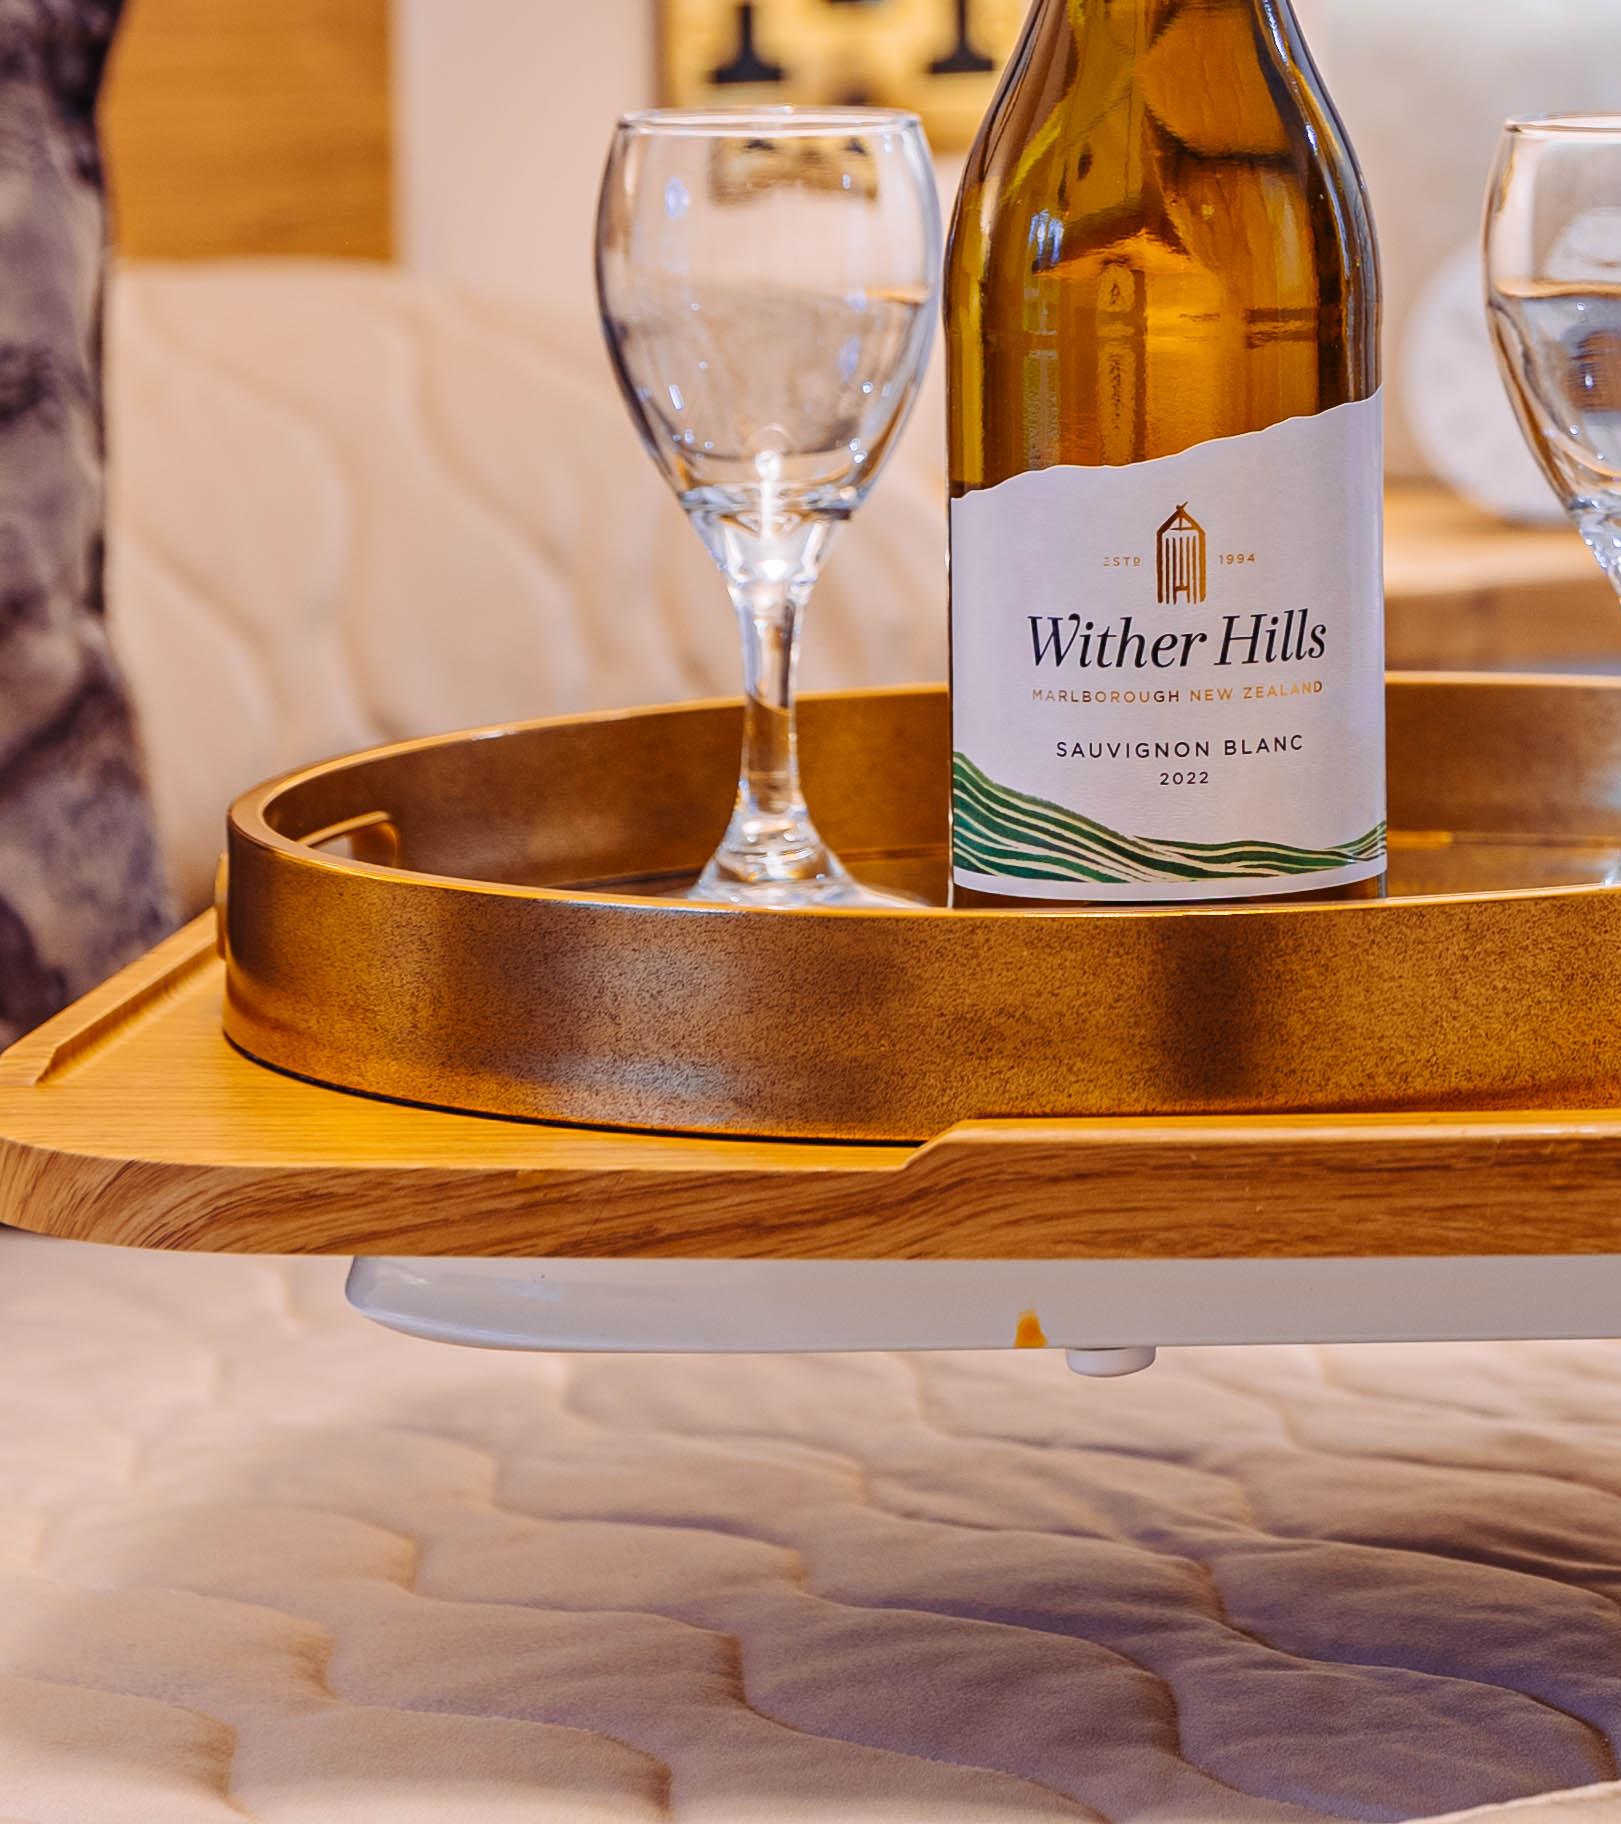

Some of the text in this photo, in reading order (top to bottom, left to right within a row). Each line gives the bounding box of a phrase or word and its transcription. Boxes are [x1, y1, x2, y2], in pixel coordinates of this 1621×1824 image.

[1218, 553, 1256, 565] 1994
[1027, 608, 1327, 668] Wither Hills
[1032, 680, 1323, 704] MARLBOROUGH NEW ZEALAND
[1056, 734, 1304, 759] SAUVIGNON BLANC
[1159, 771, 1210, 786] 2022
